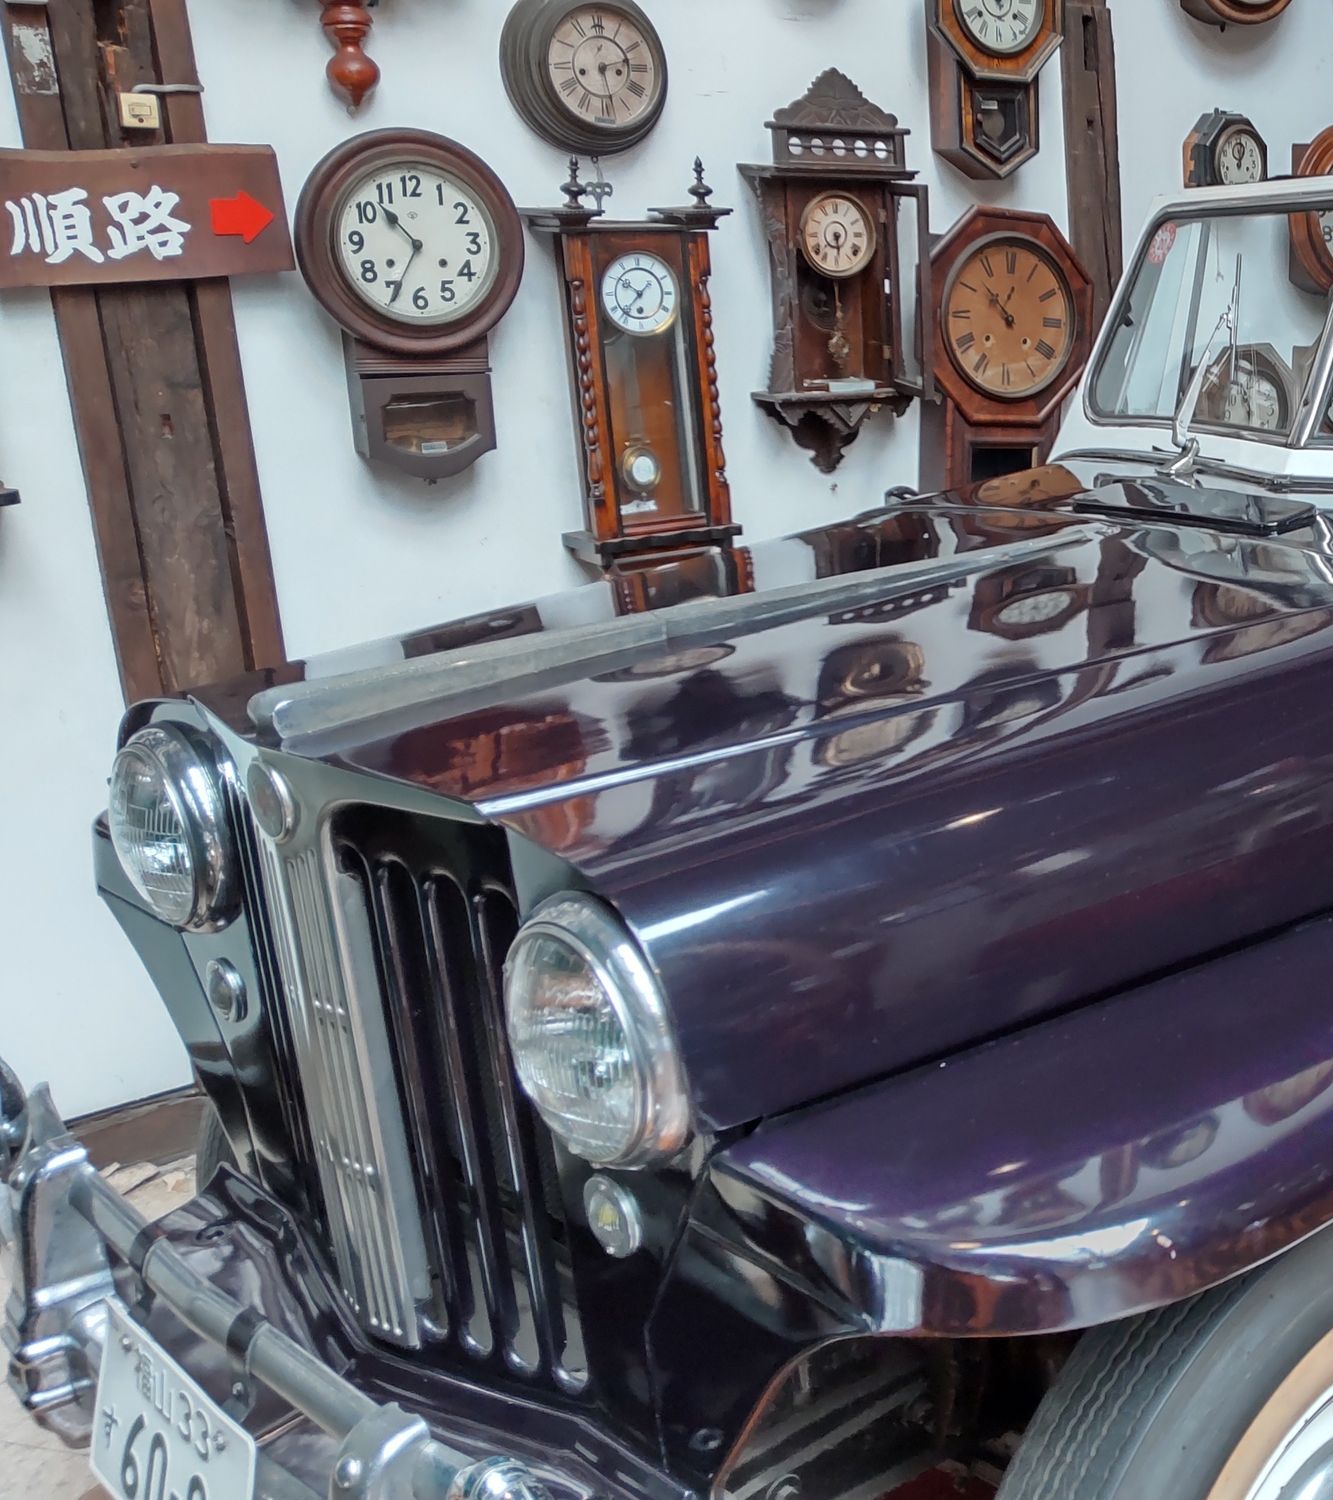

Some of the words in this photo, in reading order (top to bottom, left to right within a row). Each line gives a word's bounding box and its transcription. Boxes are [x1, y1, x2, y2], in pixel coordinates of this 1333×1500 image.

[376, 182, 393, 204] 11
[400, 175, 422, 197] 12
[436, 184, 443, 205] 1
[356, 201, 376, 224] 10
[453, 202, 470, 224] 2
[5, 185, 191, 263] 順路
[1323, 226, 1332, 241] 8
[348, 230, 364, 254] 9
[465, 232, 481, 255] 3
[361, 260, 377, 283] 8
[457, 259, 477, 282] 4
[385, 281, 402, 303] 7
[413, 287, 428, 310] 6
[440, 280, 455, 302] 5
